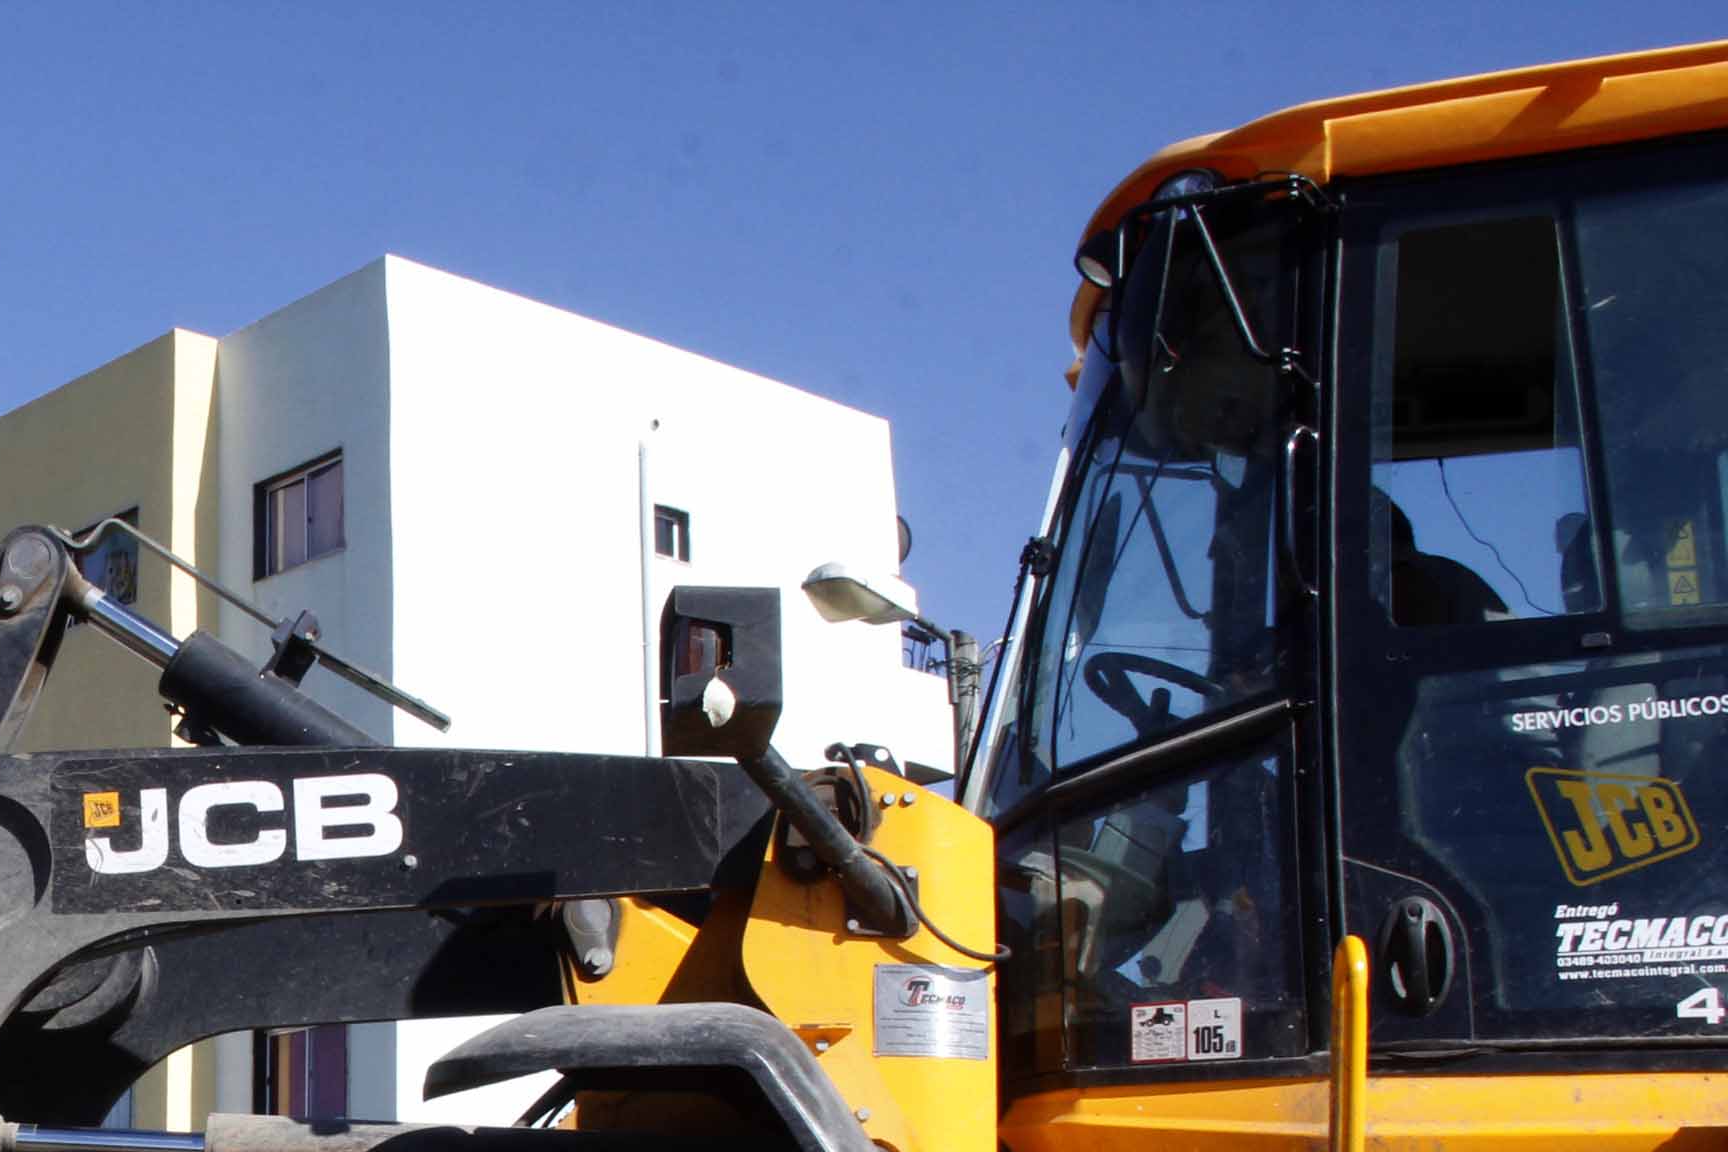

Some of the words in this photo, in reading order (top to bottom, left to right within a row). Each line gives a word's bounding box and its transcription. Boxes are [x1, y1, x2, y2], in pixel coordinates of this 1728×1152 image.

[1511, 704, 1623, 733] SERVICIOS
[1628, 694, 1728, 722] PÚBLICOS
[84, 773, 403, 875] JCB
[1555, 779, 1688, 873] JCB
[1554, 902, 1619, 919] Entregó
[1556, 914, 1728, 953] TECMACO
[1193, 1025, 1224, 1055] 105
